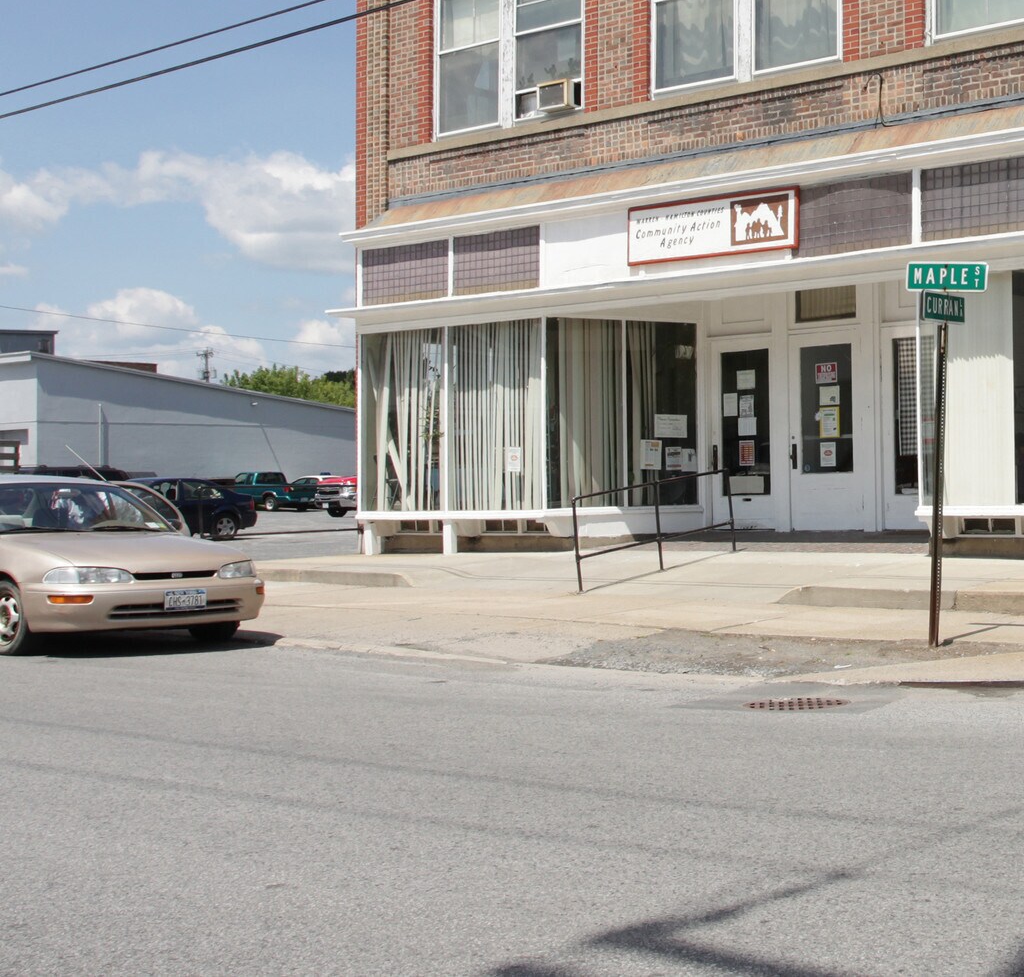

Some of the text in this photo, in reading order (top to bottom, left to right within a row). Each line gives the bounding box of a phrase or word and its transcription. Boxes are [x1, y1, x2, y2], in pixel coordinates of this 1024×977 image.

[636, 206, 725, 225] WARREN HAMILTON COUNTIES
[635, 219, 721, 240] Community Action
[659, 235, 695, 249] Agency
[913, 266, 980, 288] MAPLE ST
[926, 296, 959, 317] CURRAN
[820, 364, 832, 373] NO
